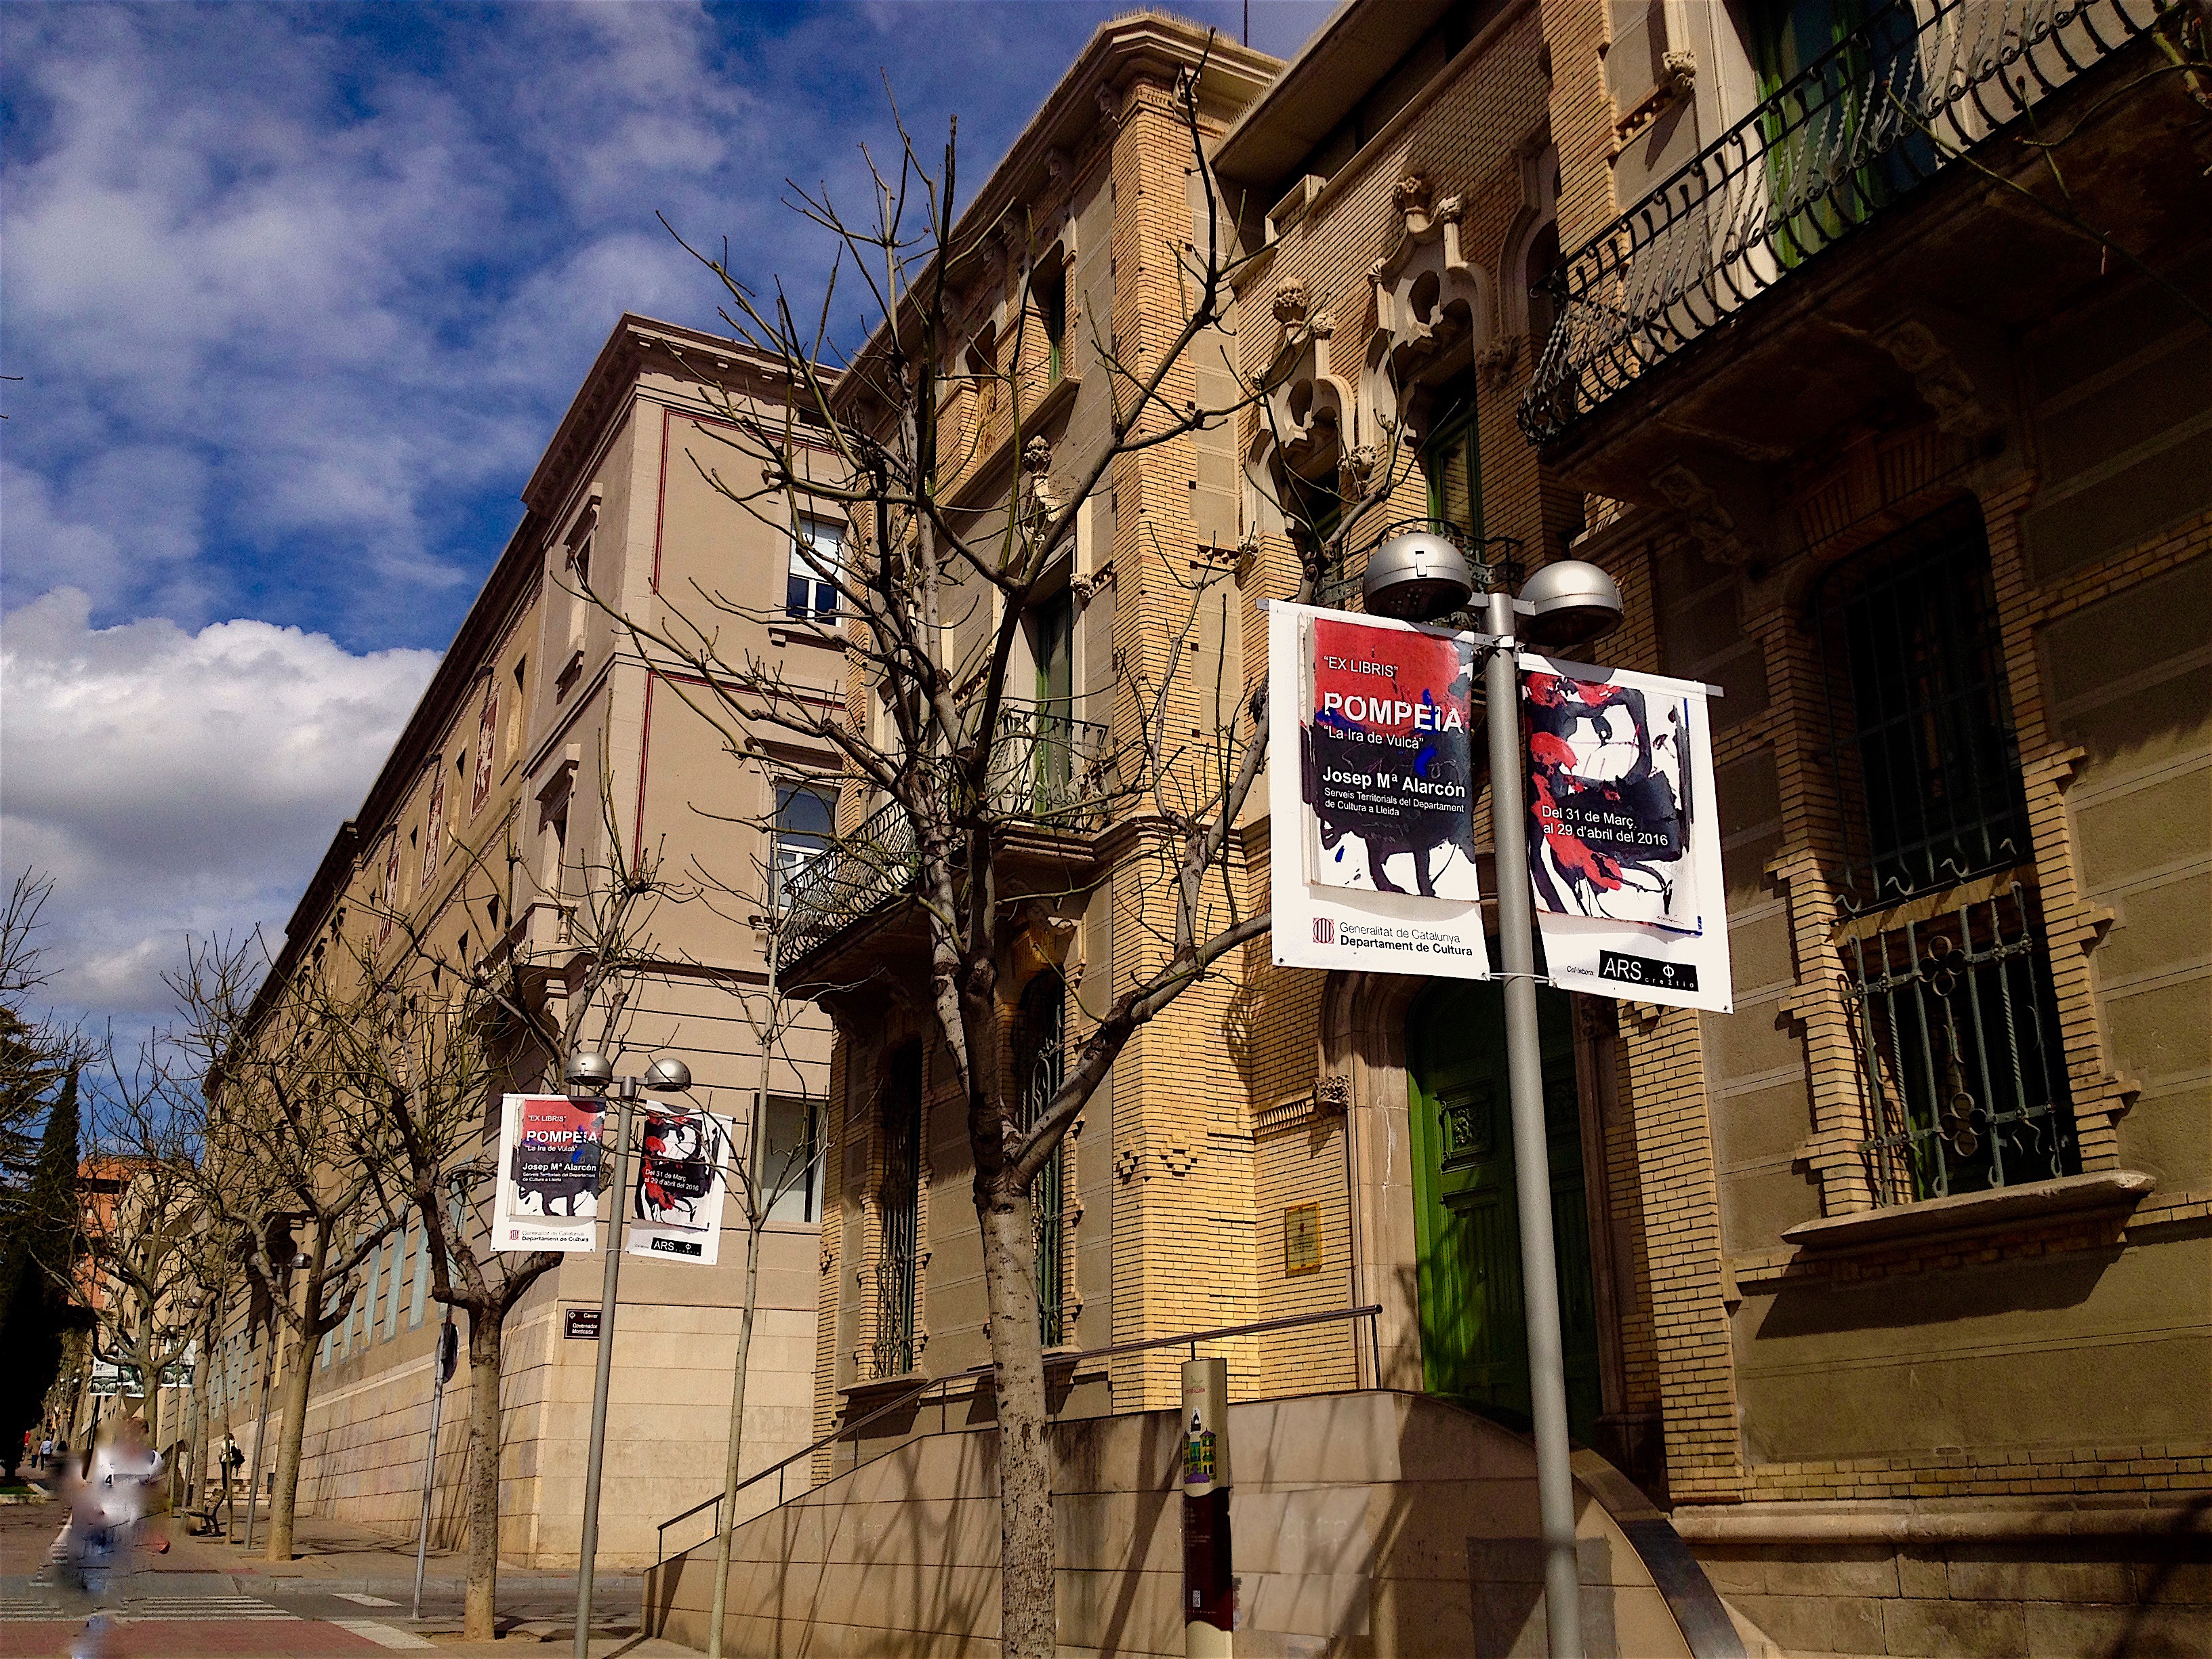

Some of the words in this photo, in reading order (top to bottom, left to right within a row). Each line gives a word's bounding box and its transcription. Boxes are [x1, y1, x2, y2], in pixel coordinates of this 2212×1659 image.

[1324, 692, 1465, 734] POMPEIA
[1348, 729, 1364, 742] Ira
[1367, 732, 1382, 744] de
[1322, 766, 1372, 789] Josep
[1377, 773, 1397, 789] Mª
[1402, 777, 1465, 798] Alarcón
[1324, 787, 1355, 799] Serveis
[1357, 791, 1397, 804] Territorials
[1399, 797, 1411, 806] del
[1413, 798, 1465, 813] Departament
[1325, 800, 1335, 808] de
[1337, 801, 1366, 812] Cultura
[1376, 805, 1399, 816] Lleida
[1542, 805, 1562, 819] Del
[1566, 808, 1580, 821] 31
[1584, 811, 1600, 823] de
[1543, 823, 1553, 834] al
[1557, 824, 1573, 836] 29
[1576, 826, 1613, 840] d'abril
[1616, 830, 1634, 842] del
[1637, 832, 1668, 846] 2016
[1340, 922, 1392, 937] Generalitat
[1396, 928, 1409, 938] de
[1412, 929, 1460, 945] Catalunya
[1340, 935, 1413, 951] Departament
[1416, 942, 1429, 953] de
[1433, 943, 1473, 956] Cultura
[1603, 957, 1641, 981] ARS
[526, 1130, 598, 1143] POMPEIA
[522, 1162, 549, 1172] Josep
[564, 1163, 596, 1171] Alarcón
[653, 1240, 674, 1251] ARS
